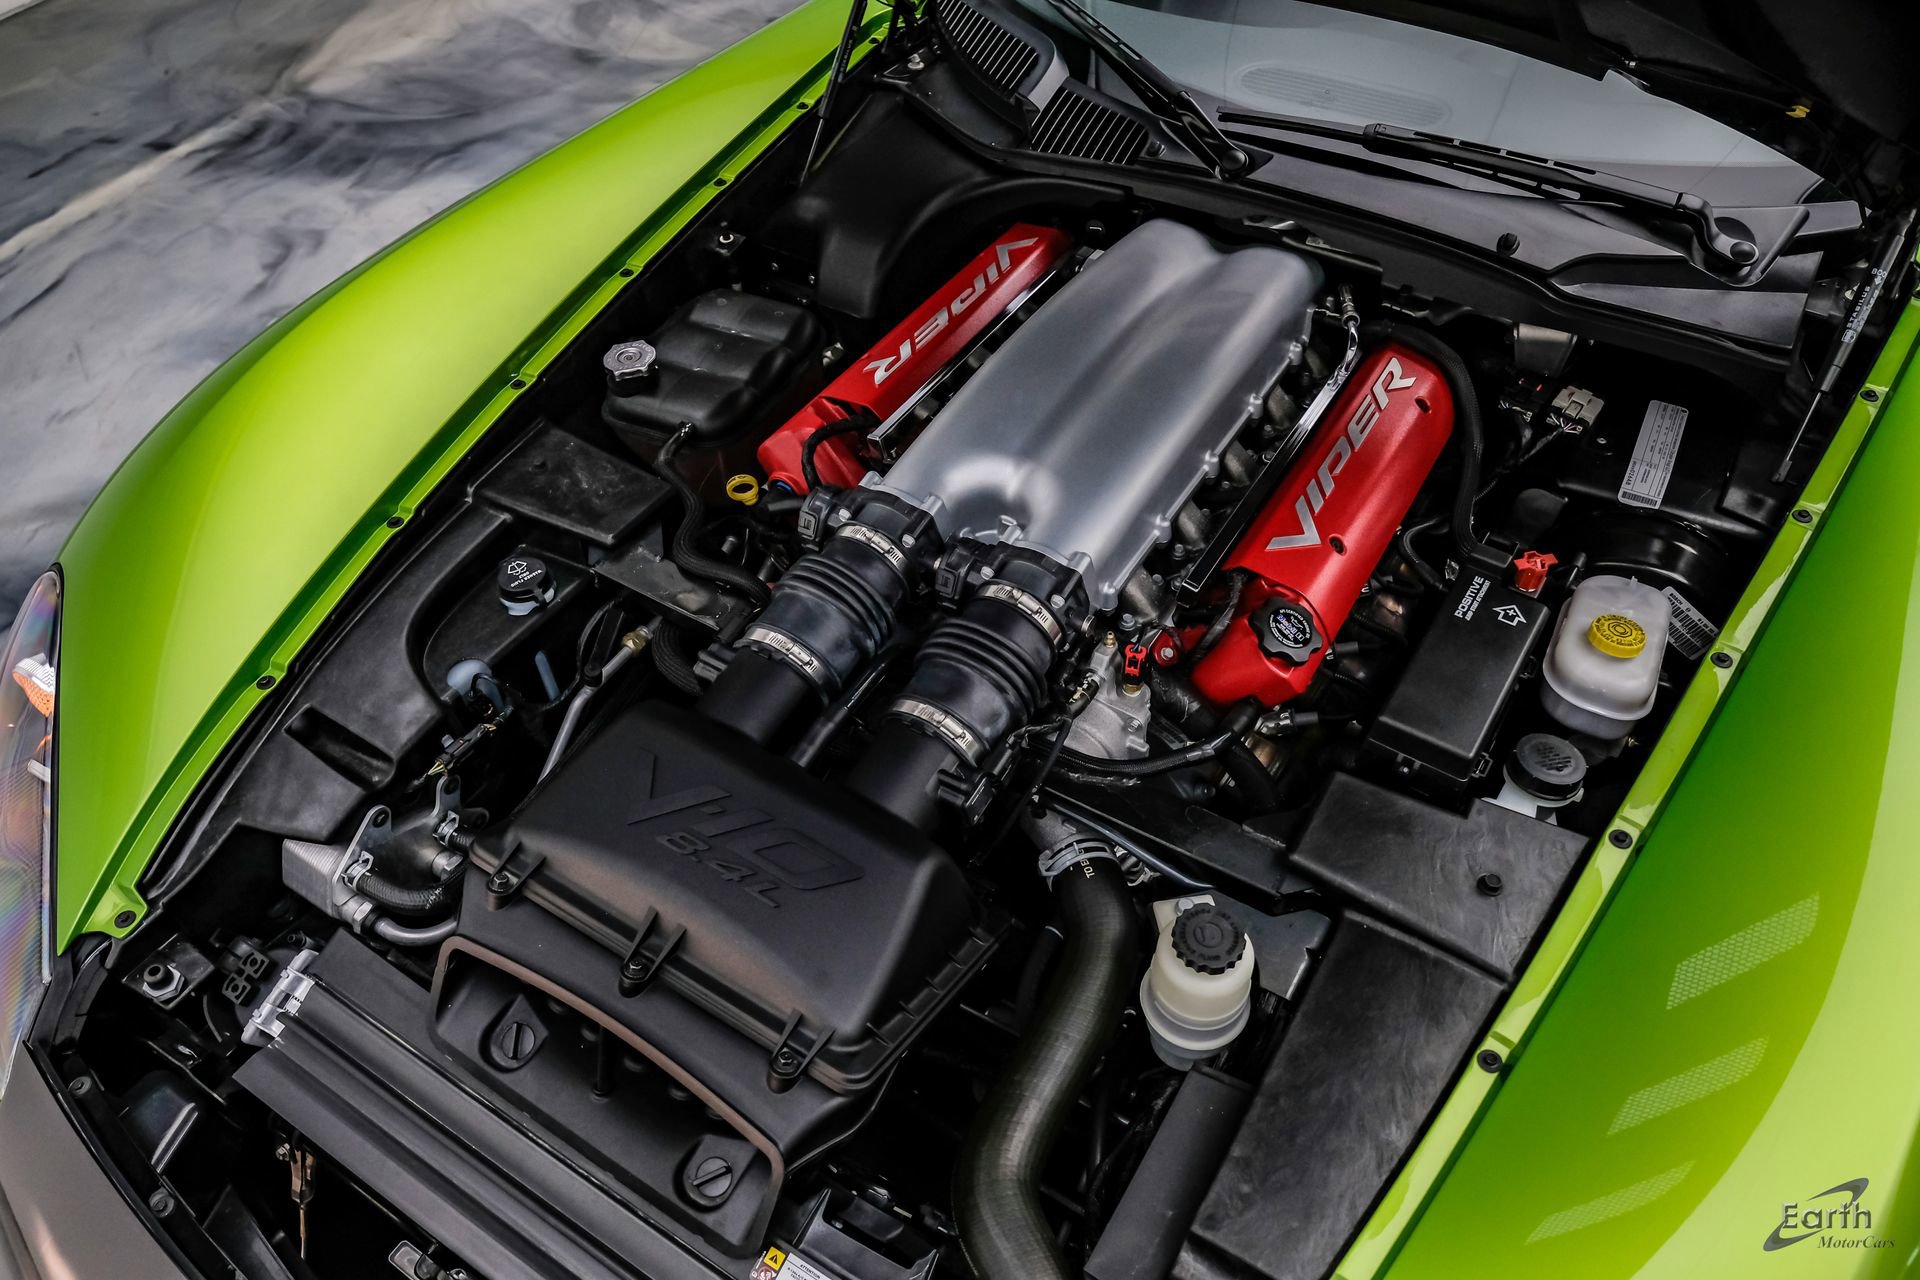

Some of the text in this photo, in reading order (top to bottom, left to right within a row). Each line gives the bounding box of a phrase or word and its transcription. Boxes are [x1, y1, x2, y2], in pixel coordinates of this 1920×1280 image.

[863, 237, 1039, 385] VIPER
[1846, 286, 1871, 328] STABILUS
[1265, 357, 1417, 550] VIPER
[1454, 576, 1484, 618] POSITIVE
[1669, 593, 1683, 606] BOSCH
[655, 831, 781, 908] 8.4L
